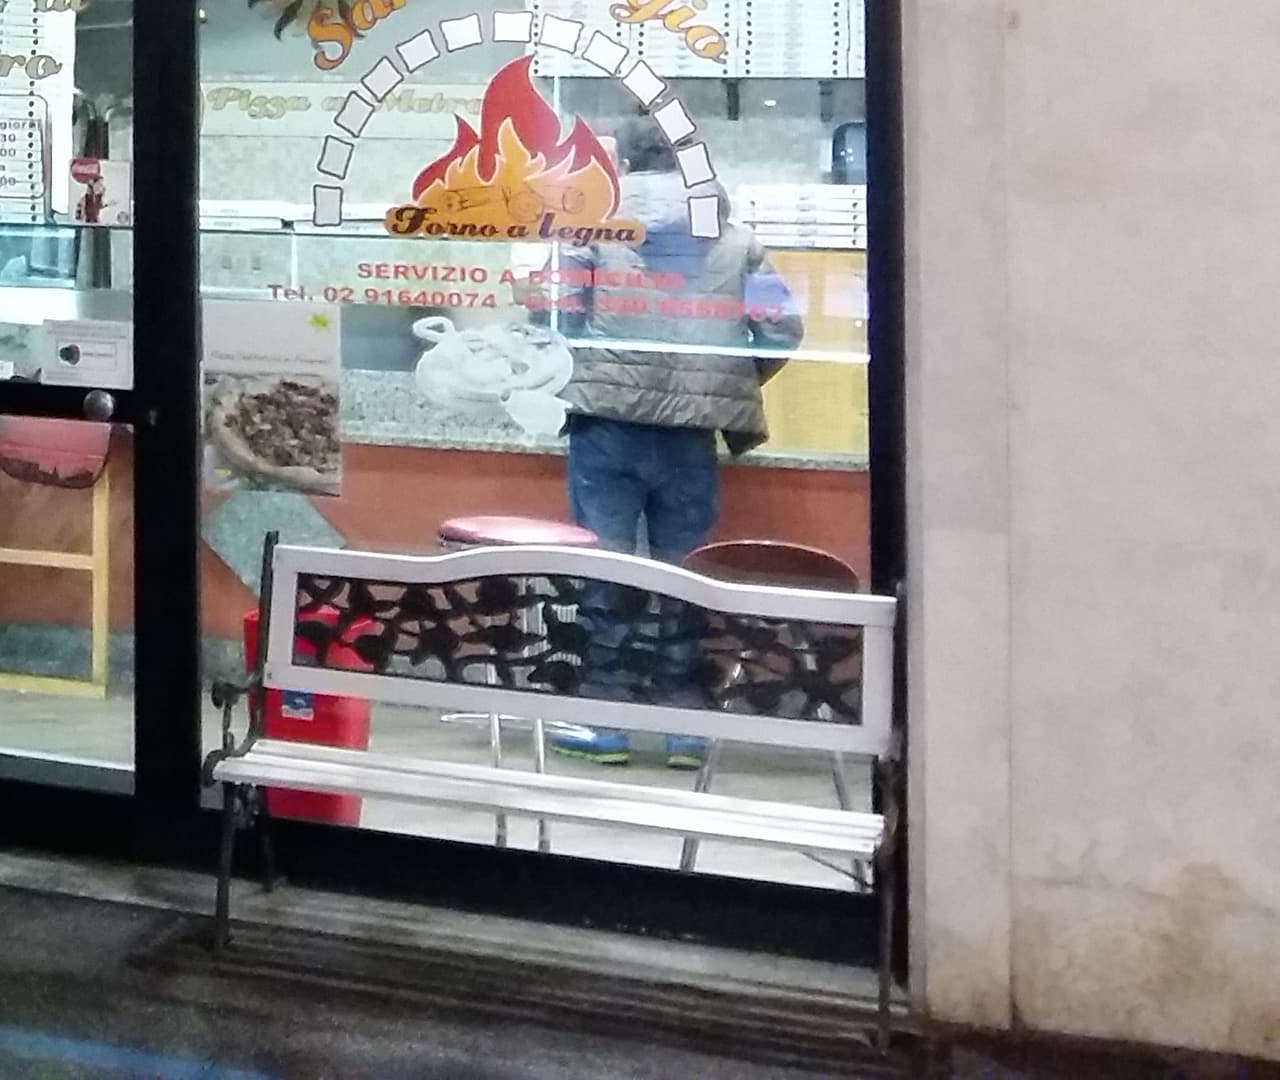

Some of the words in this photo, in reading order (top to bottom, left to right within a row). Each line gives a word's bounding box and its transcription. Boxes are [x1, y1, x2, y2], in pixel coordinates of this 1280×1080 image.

[391, 206, 500, 236] Forno
[507, 223, 529, 238] a
[357, 262, 488, 284] SERVIZIO
[499, 269, 517, 285] A
[267, 284, 313, 301] Tel.
[323, 286, 354, 303] 02
[364, 287, 497, 308] 91640074
